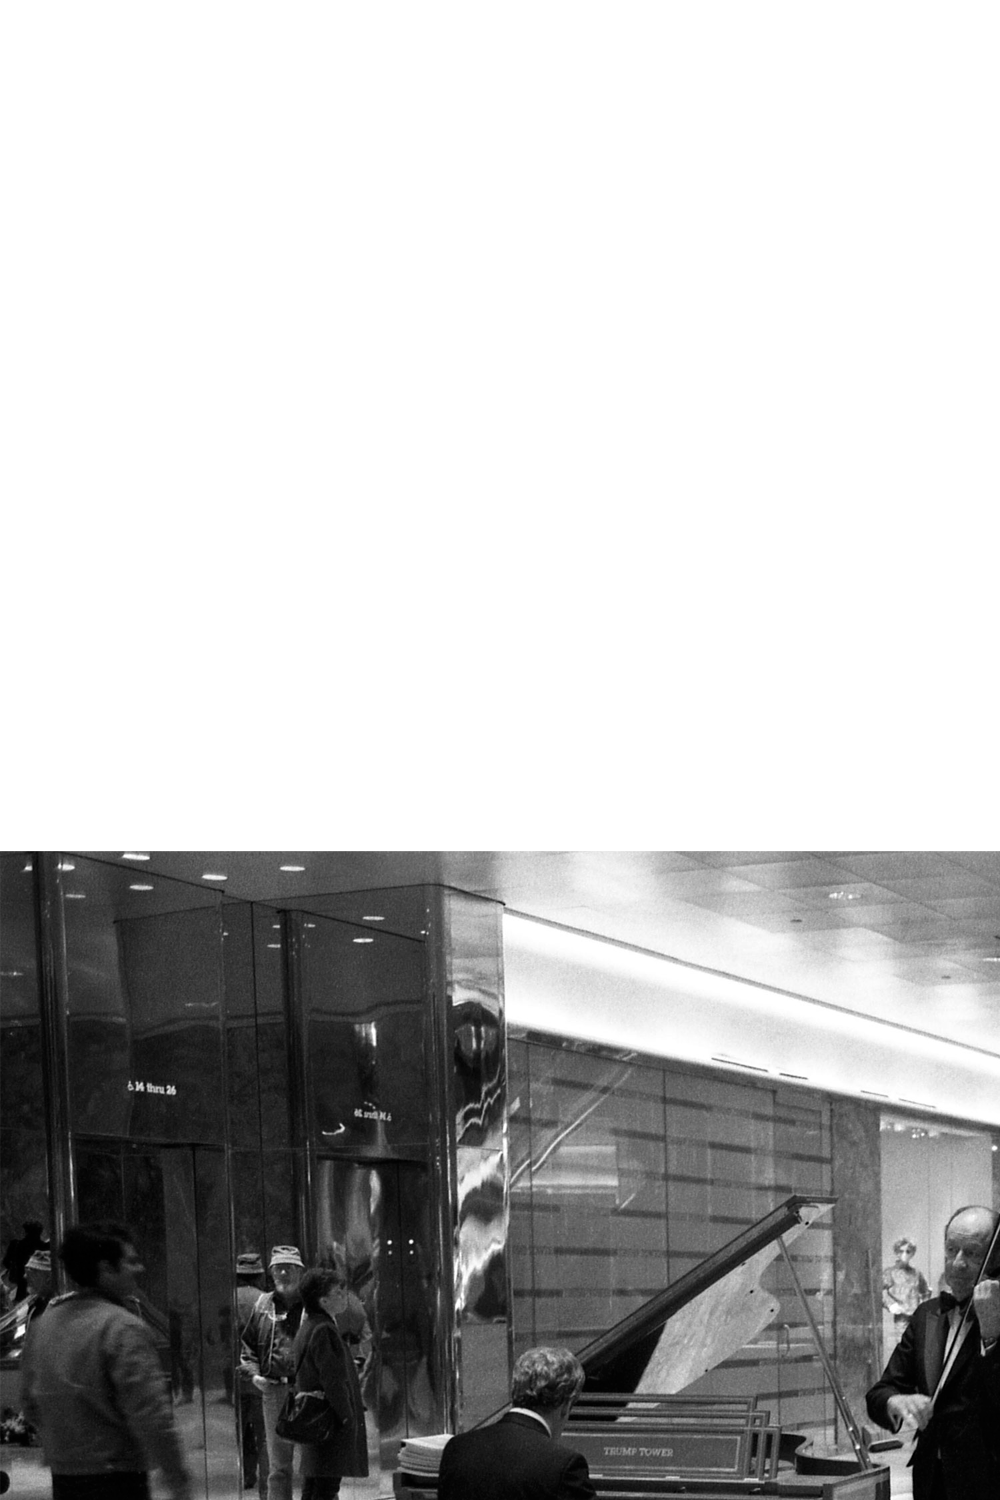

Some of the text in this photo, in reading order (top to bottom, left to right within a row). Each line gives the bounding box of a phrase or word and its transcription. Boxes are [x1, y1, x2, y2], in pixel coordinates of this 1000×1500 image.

[146, 1082, 165, 1094] thru
[603, 1447, 674, 1457] TRUMP TOWER
